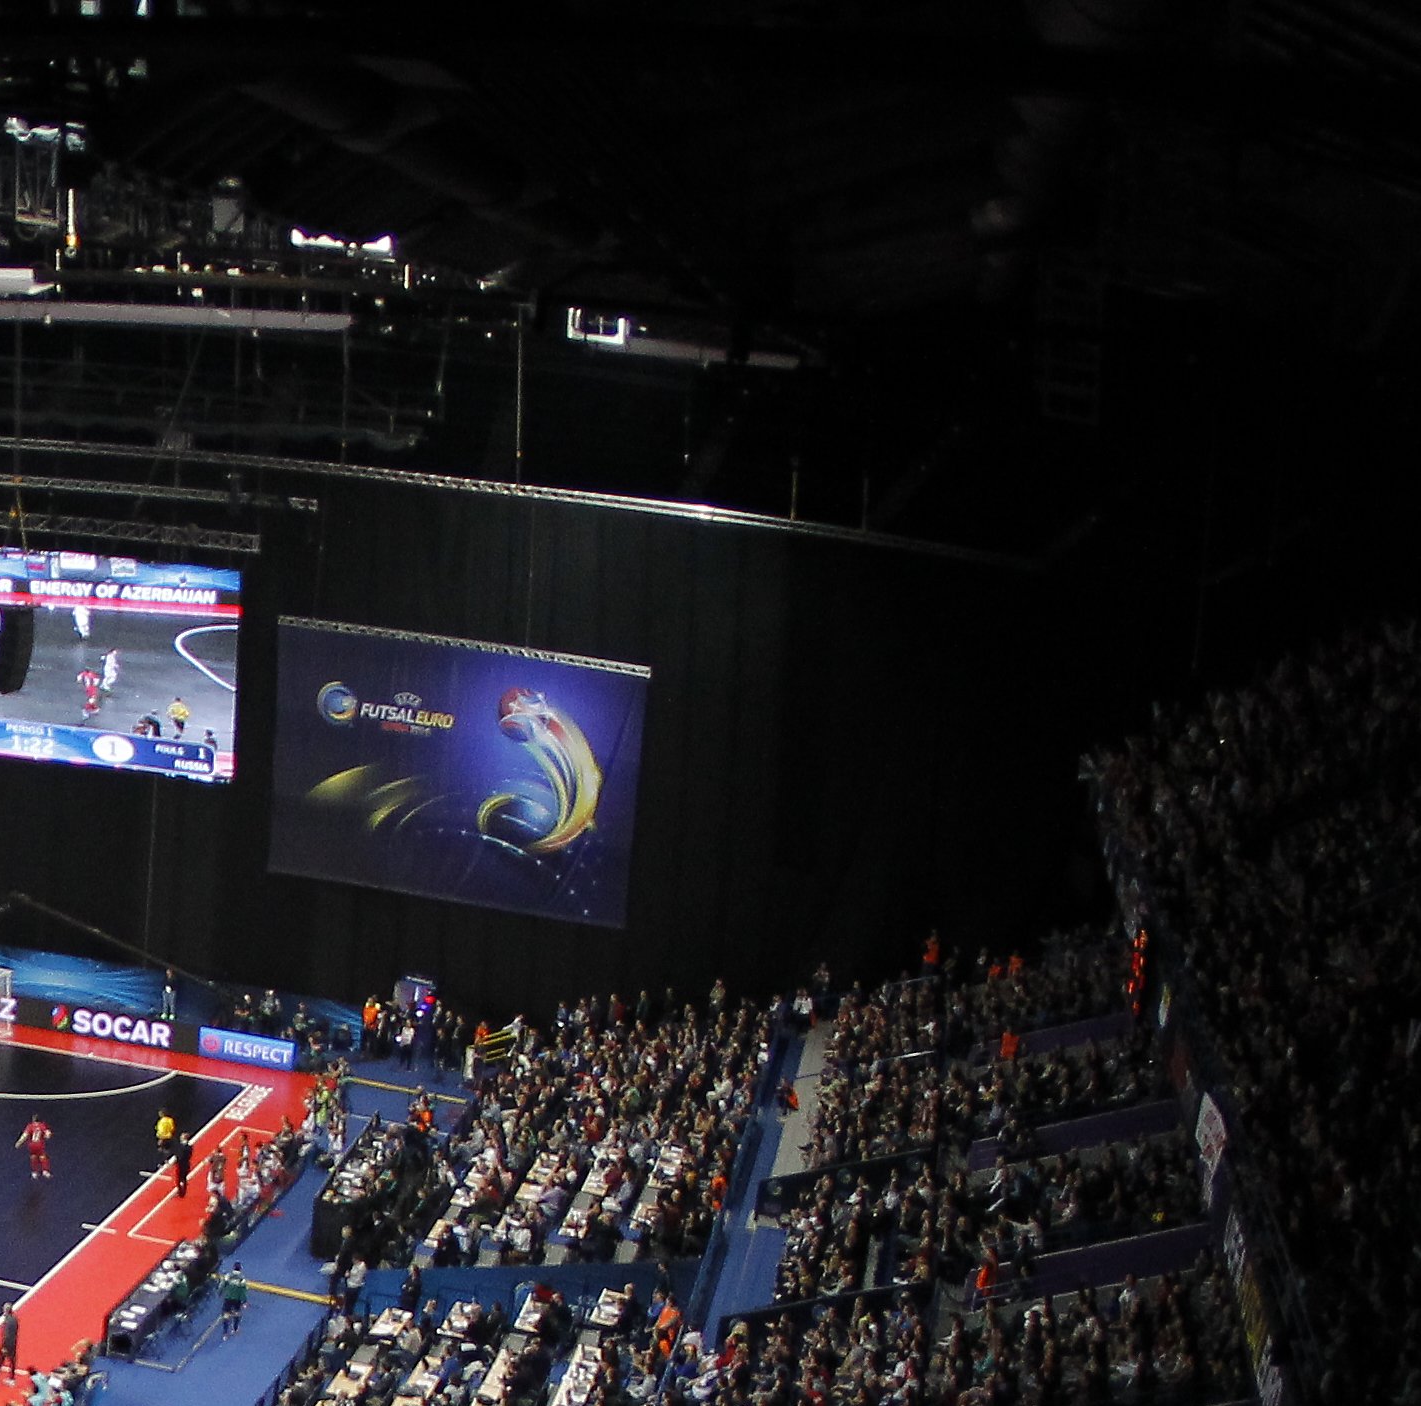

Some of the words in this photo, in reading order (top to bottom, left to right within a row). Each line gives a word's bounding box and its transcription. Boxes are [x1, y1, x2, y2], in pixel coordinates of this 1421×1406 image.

[30, 580, 93, 597] ENERGY
[95, 583, 119, 599] OF
[120, 585, 217, 605] AZERBAIJAN
[11, 735, 55, 755] 1:22
[71, 1008, 172, 1048] SOCAR
[223, 1038, 293, 1065] RESPECT
